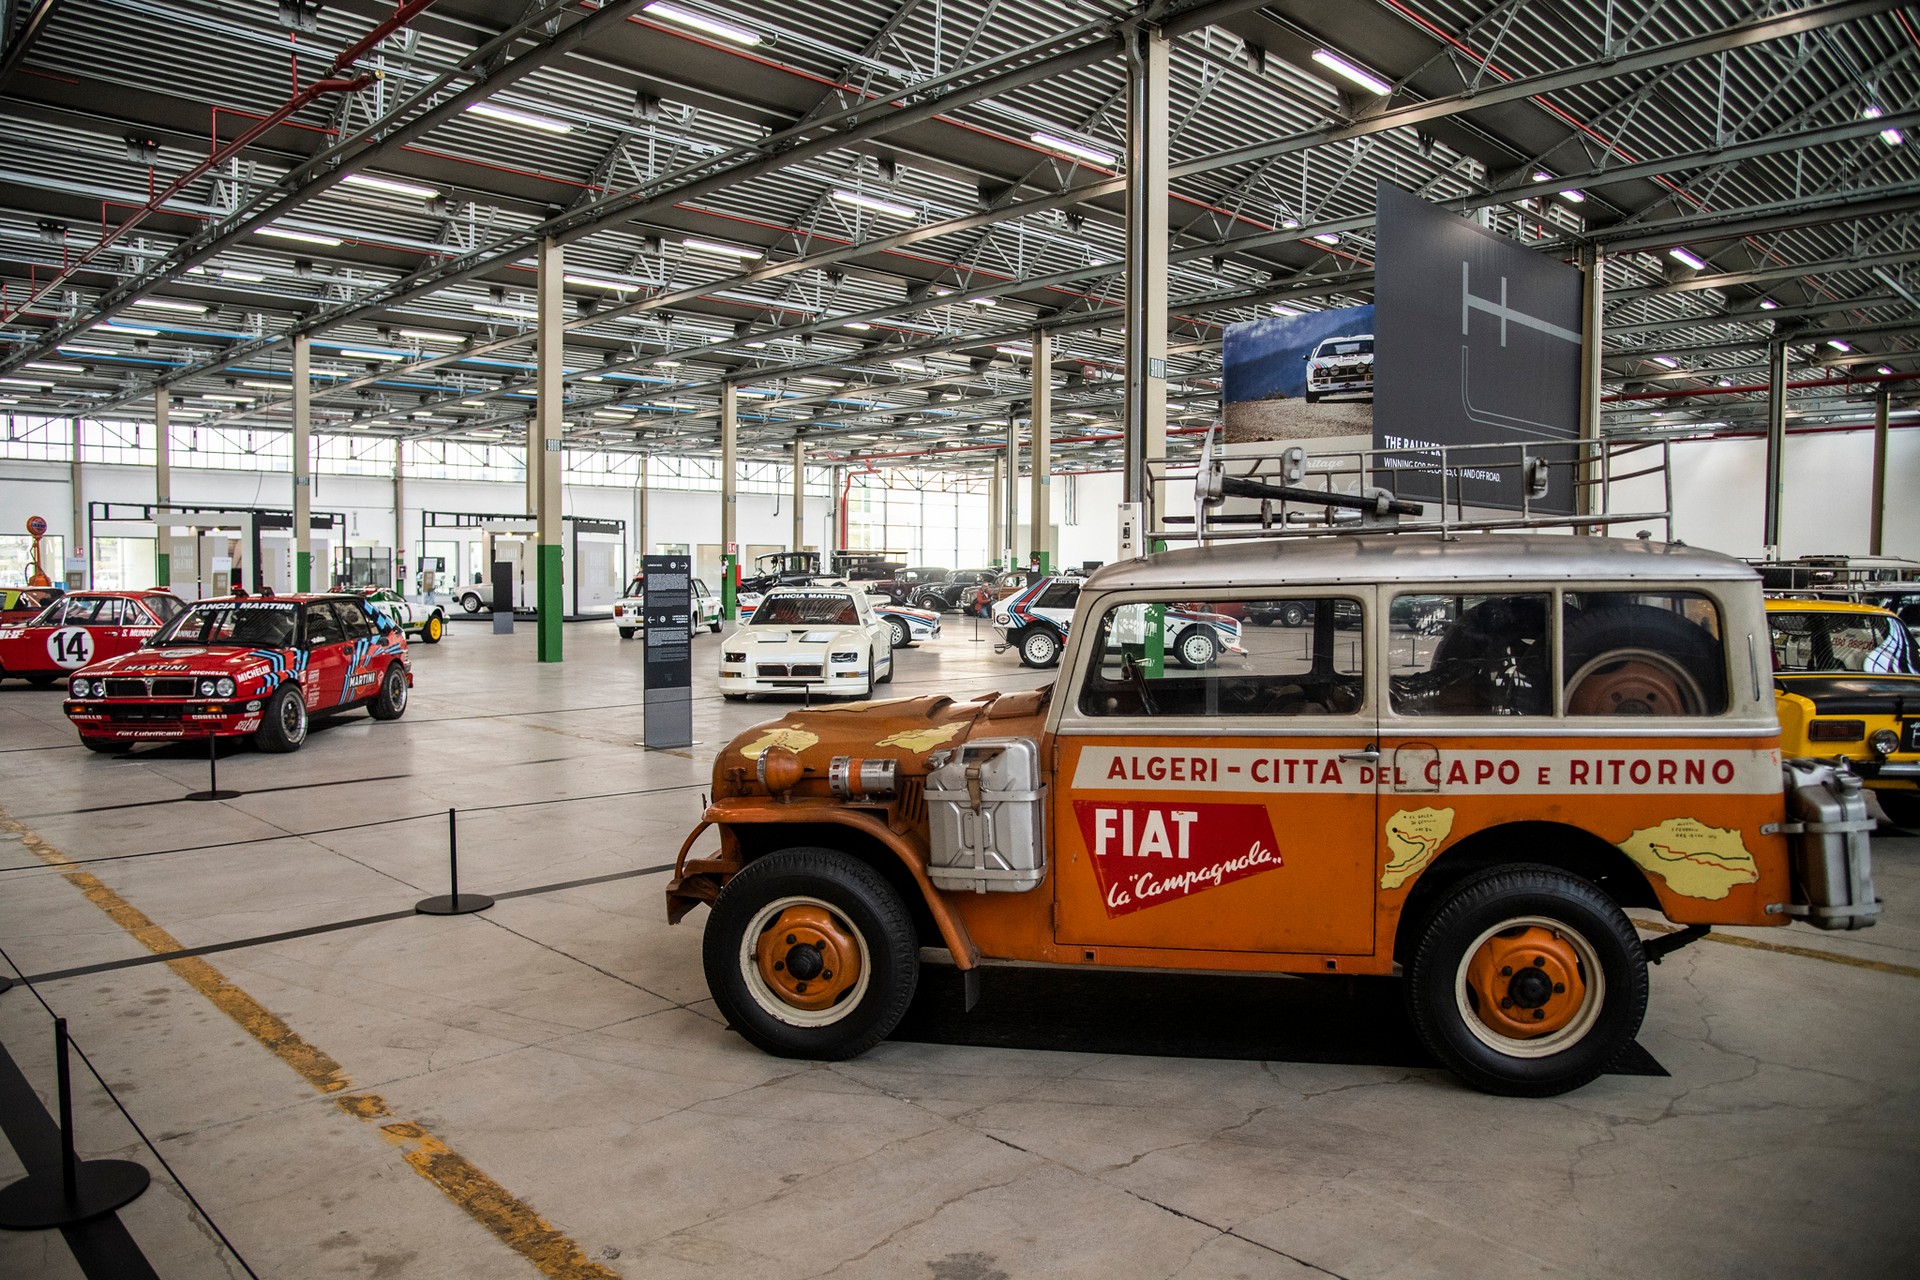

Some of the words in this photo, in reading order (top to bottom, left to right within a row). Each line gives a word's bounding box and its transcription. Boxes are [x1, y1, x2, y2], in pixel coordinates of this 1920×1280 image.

[1384, 435, 1402, 449] THE
[53, 631, 88, 661] 14
[237, 665, 271, 682] MICHELIN
[350, 672, 376, 687] MARTINI
[1107, 756, 1217, 782] ALGERI
[1360, 767, 1407, 785] DEL
[1424, 760, 1520, 785] CAPO
[1538, 767, 1551, 785] E
[1570, 759, 1734, 785] RITORNO
[1095, 808, 1198, 859] FIAT
